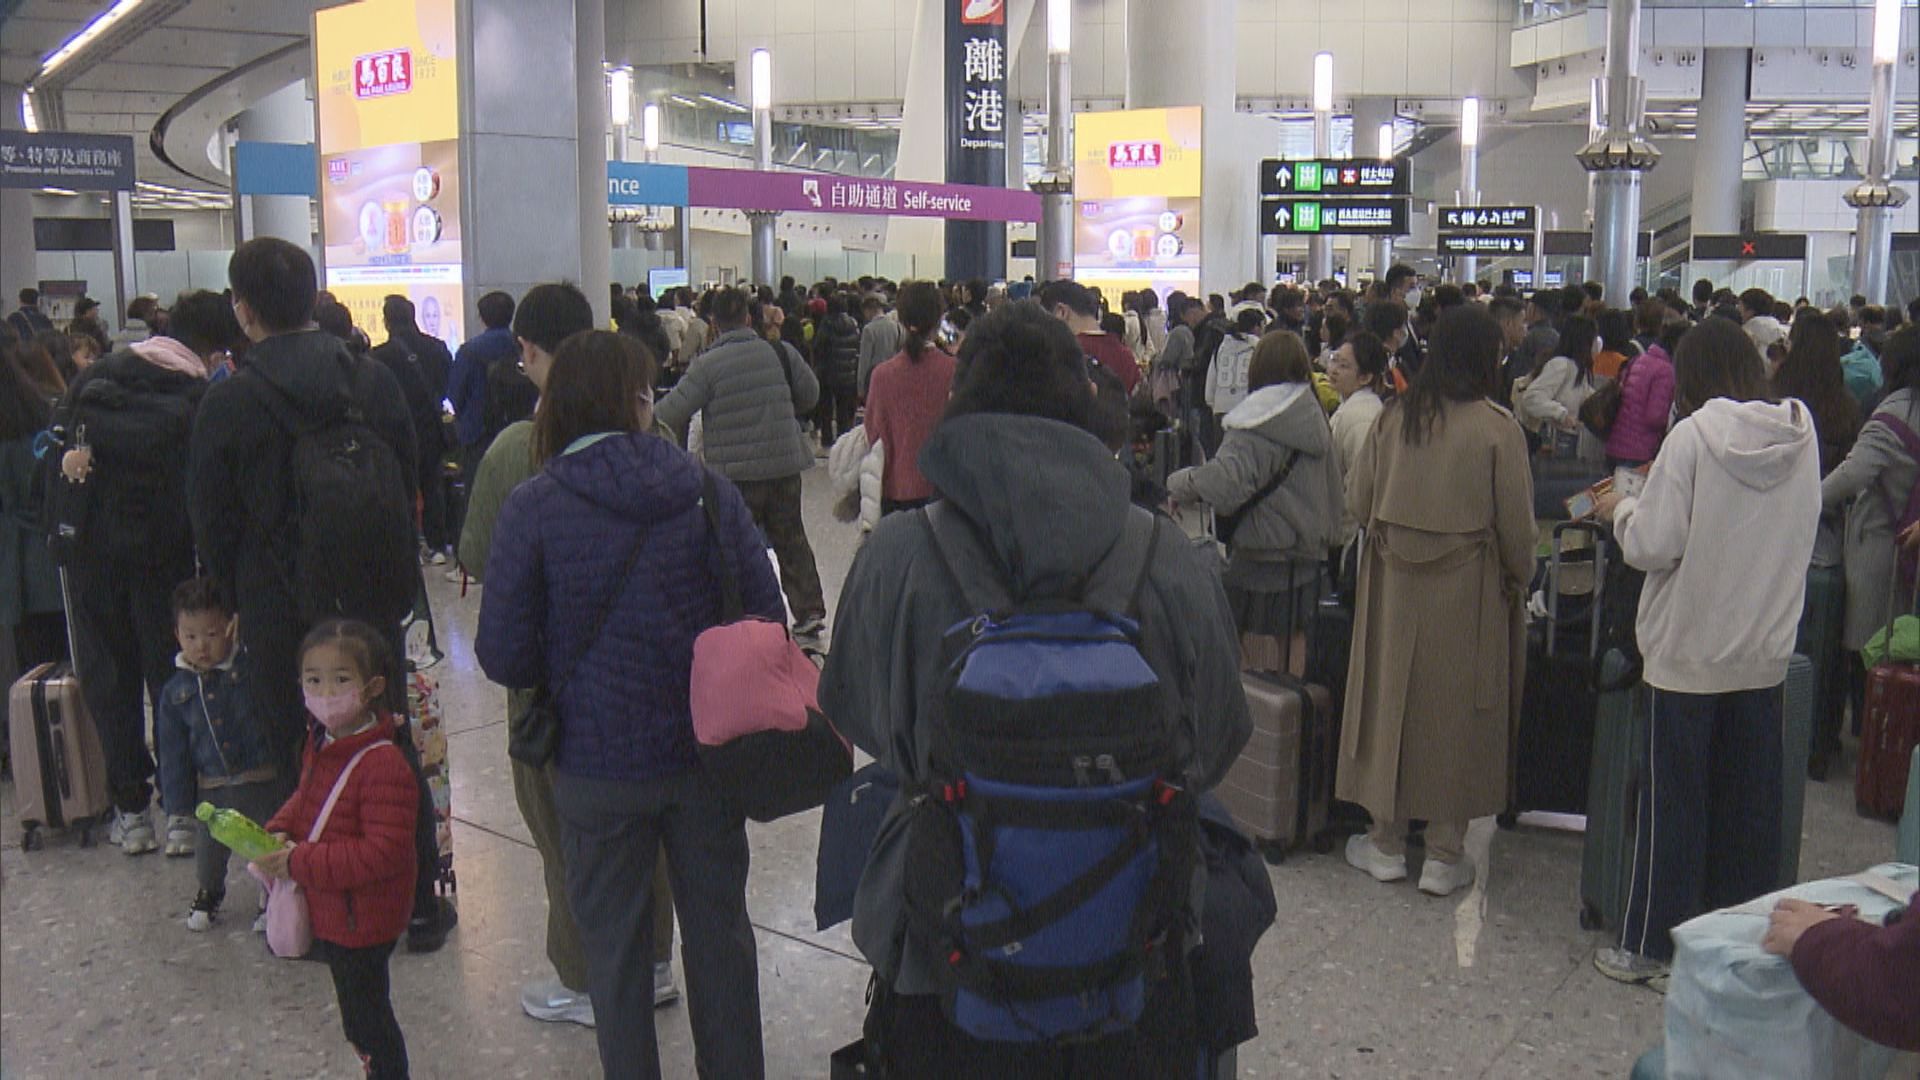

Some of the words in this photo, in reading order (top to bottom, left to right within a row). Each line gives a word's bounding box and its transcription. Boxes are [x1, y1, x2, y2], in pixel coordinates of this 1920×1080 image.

[360, 53, 406, 88] 馬百良
[964, 38, 1002, 131] 離港
[608, 177, 640, 195] nce
[832, 182, 897, 209] 自助通道
[904, 189, 971, 212] Self-service
